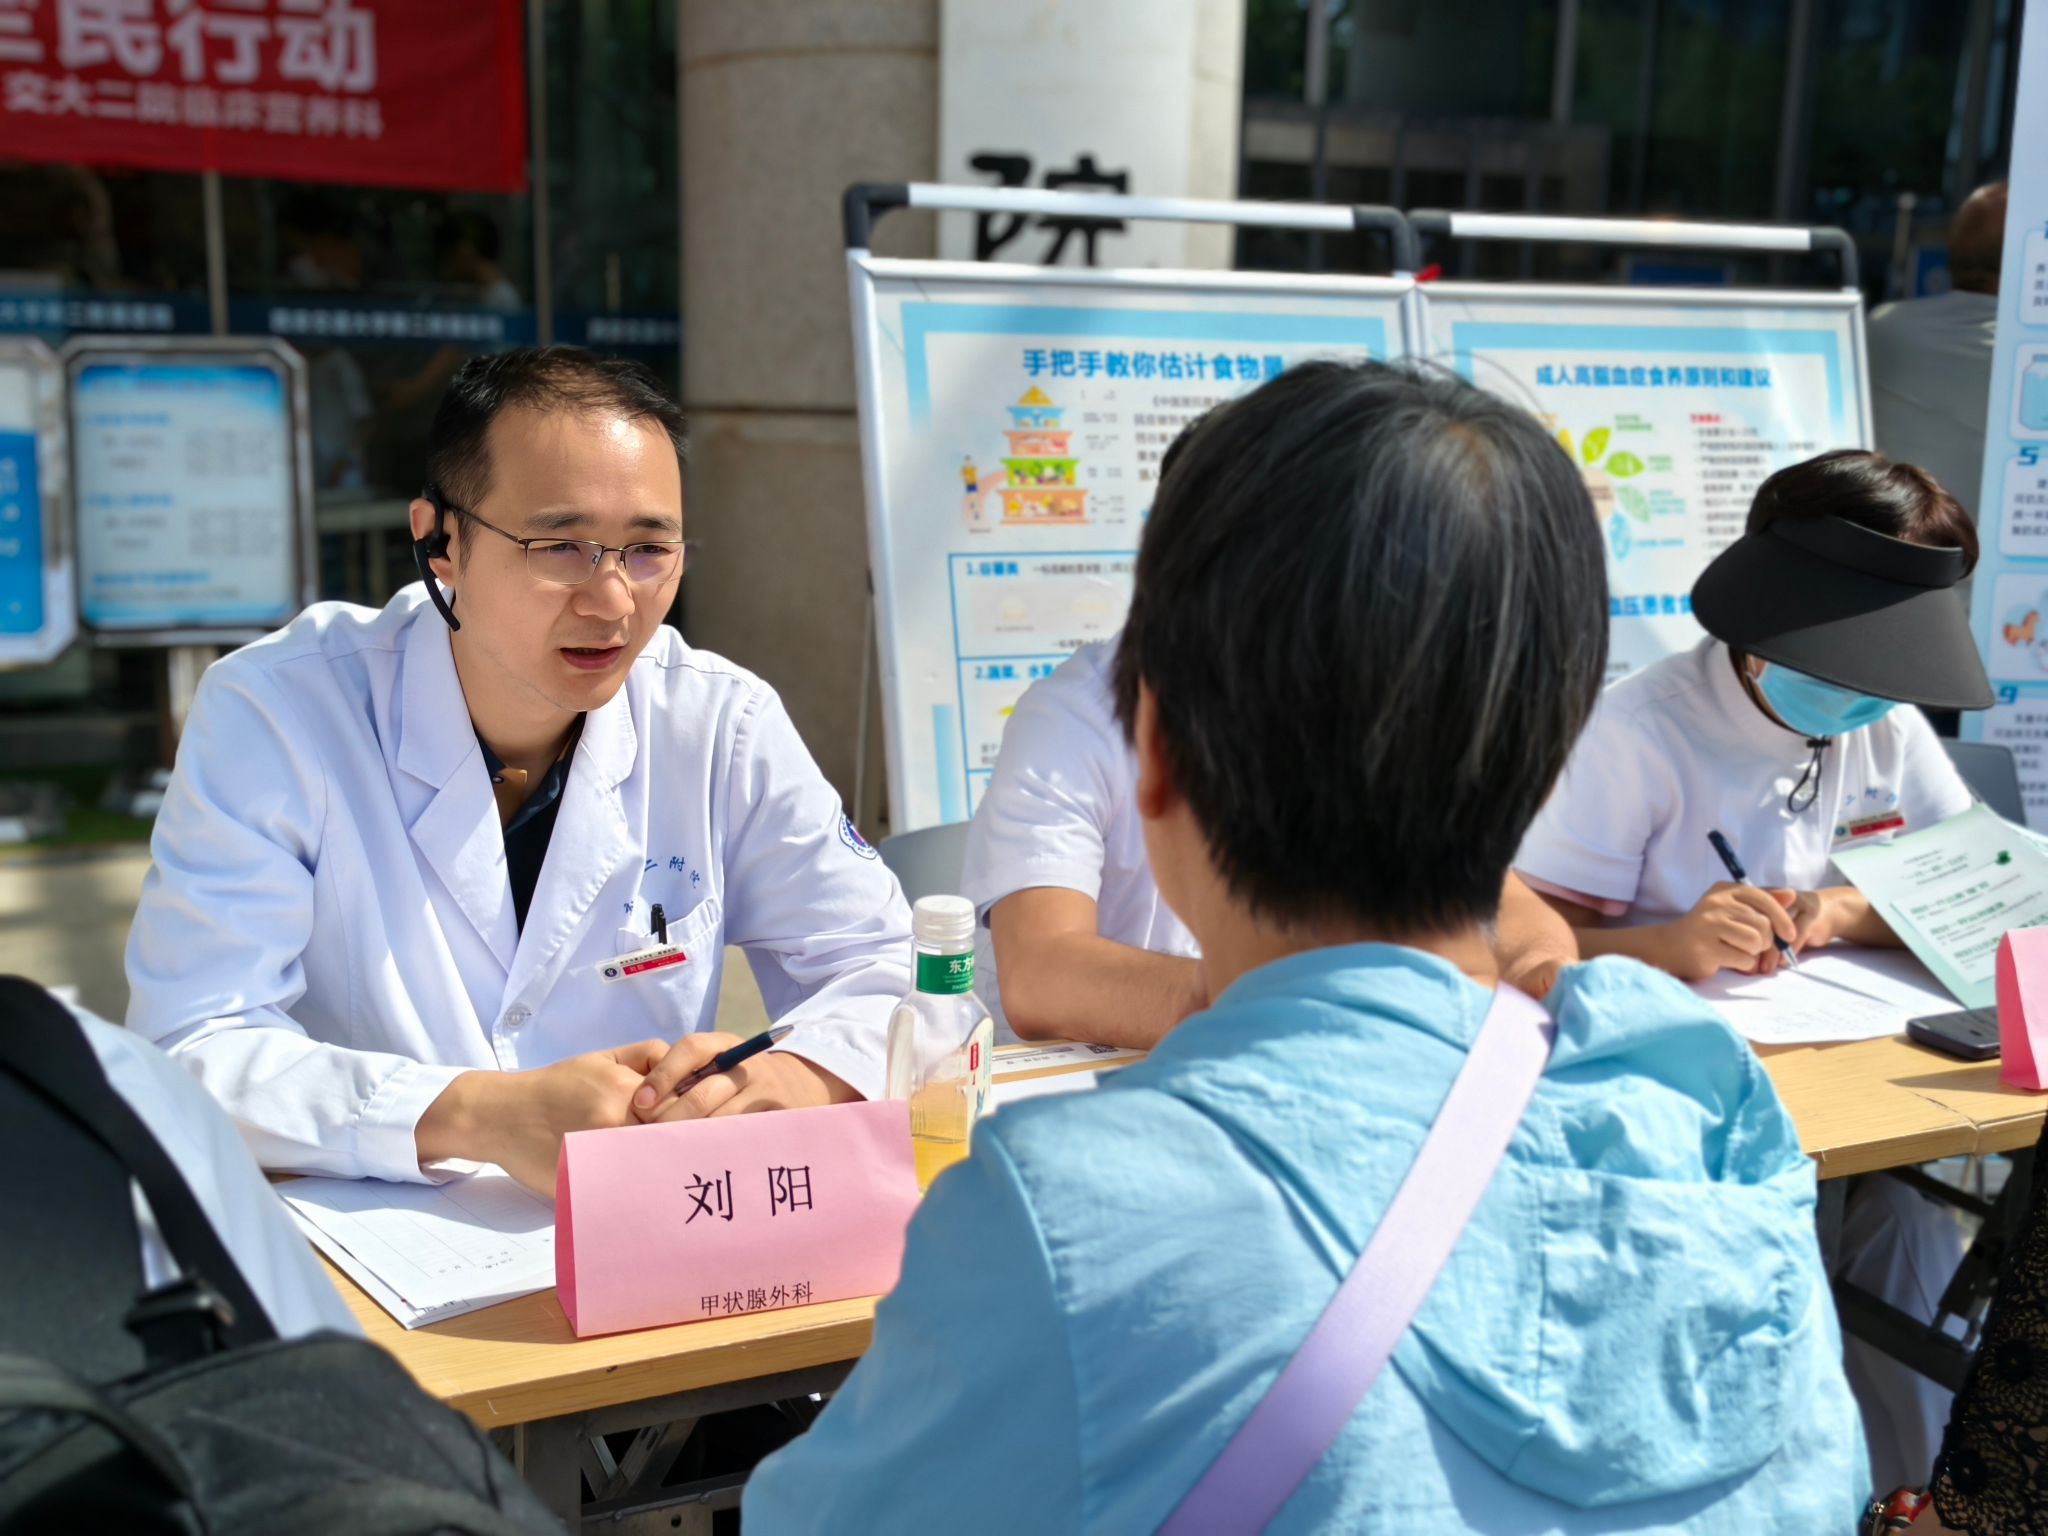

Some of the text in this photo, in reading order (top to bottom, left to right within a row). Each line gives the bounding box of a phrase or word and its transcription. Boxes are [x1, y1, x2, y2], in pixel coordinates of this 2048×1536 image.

[2017, 447, 2038, 466] 5
[949, 955, 975, 974] 东方
[684, 1165, 813, 1225] 刘 阳
[700, 1280, 814, 1317] 甲状腺外科
